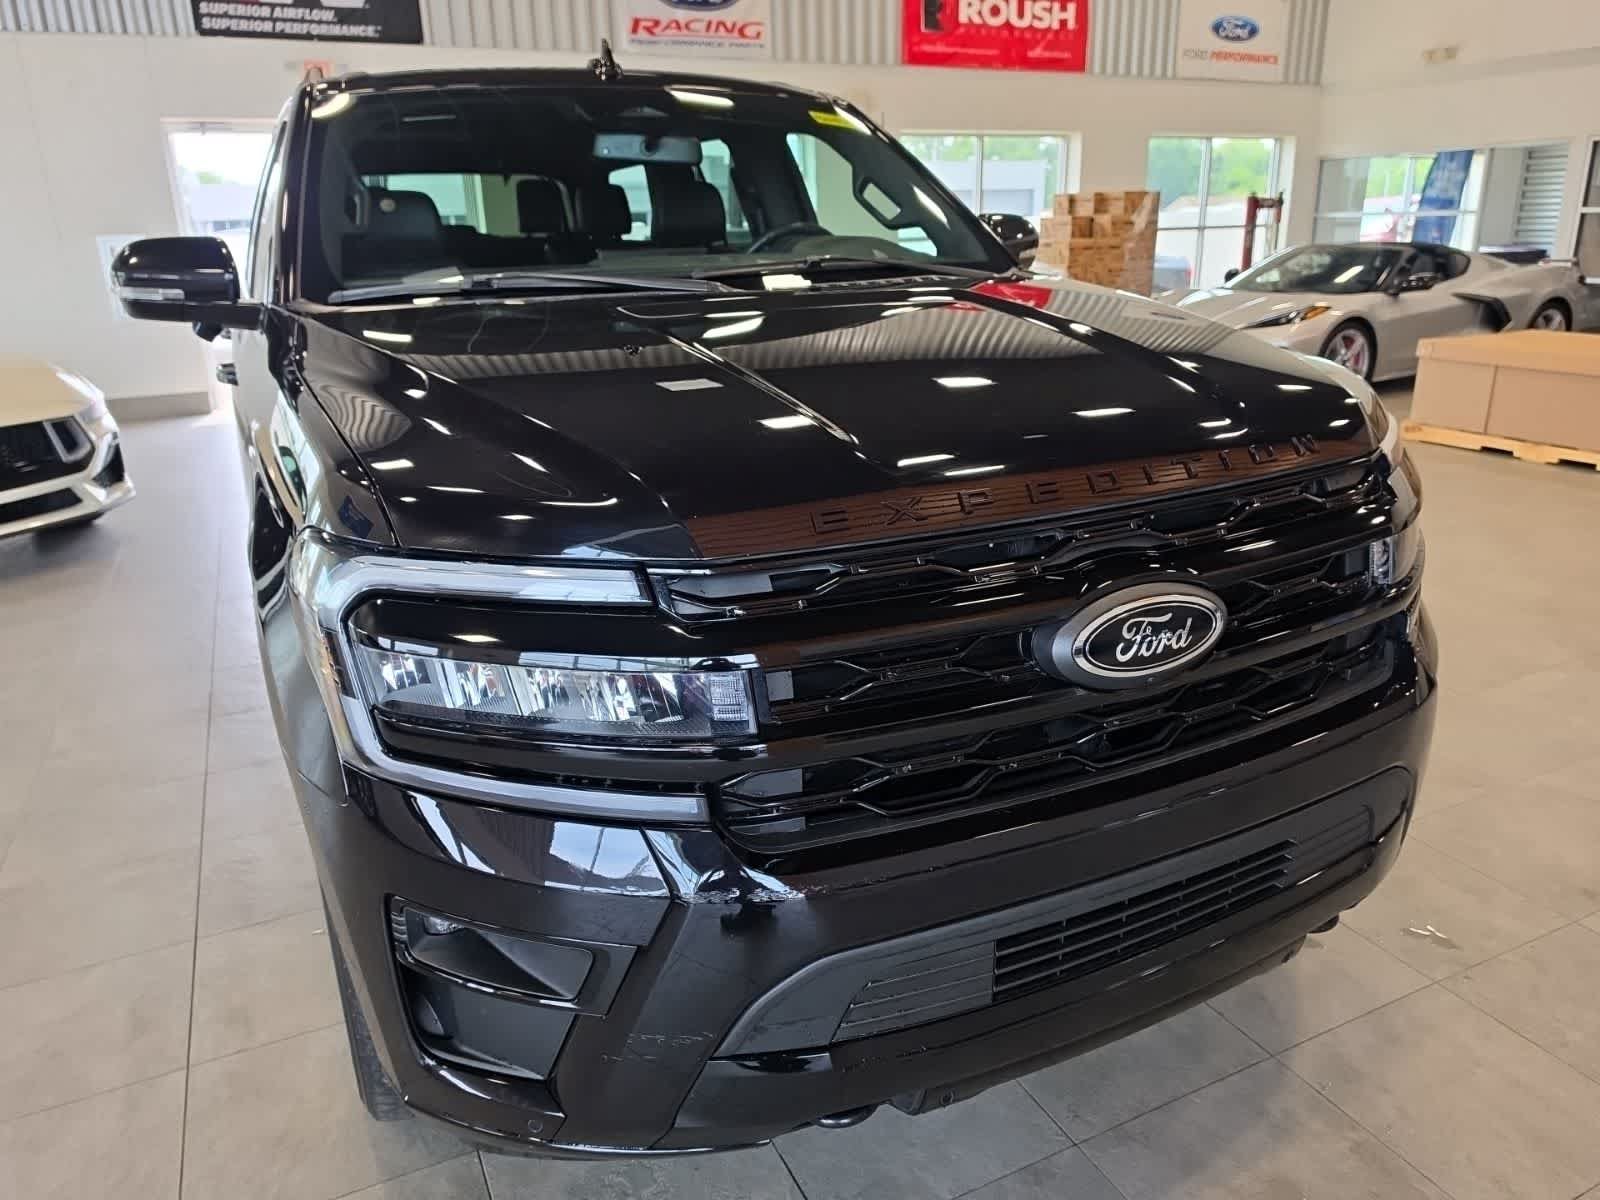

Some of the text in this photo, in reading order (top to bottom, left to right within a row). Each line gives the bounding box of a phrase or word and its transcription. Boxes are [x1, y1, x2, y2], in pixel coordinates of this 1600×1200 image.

[199, 1, 271, 18] SUPERIOR
[272, 6, 337, 22] AIRFLOW.
[201, 17, 274, 33] SUPERIOR
[958, 0, 1077, 30] ROUSH
[630, 16, 765, 40] RACING
[809, 433, 1320, 535] EXPEDITION
[1115, 612, 1193, 663] Ford
